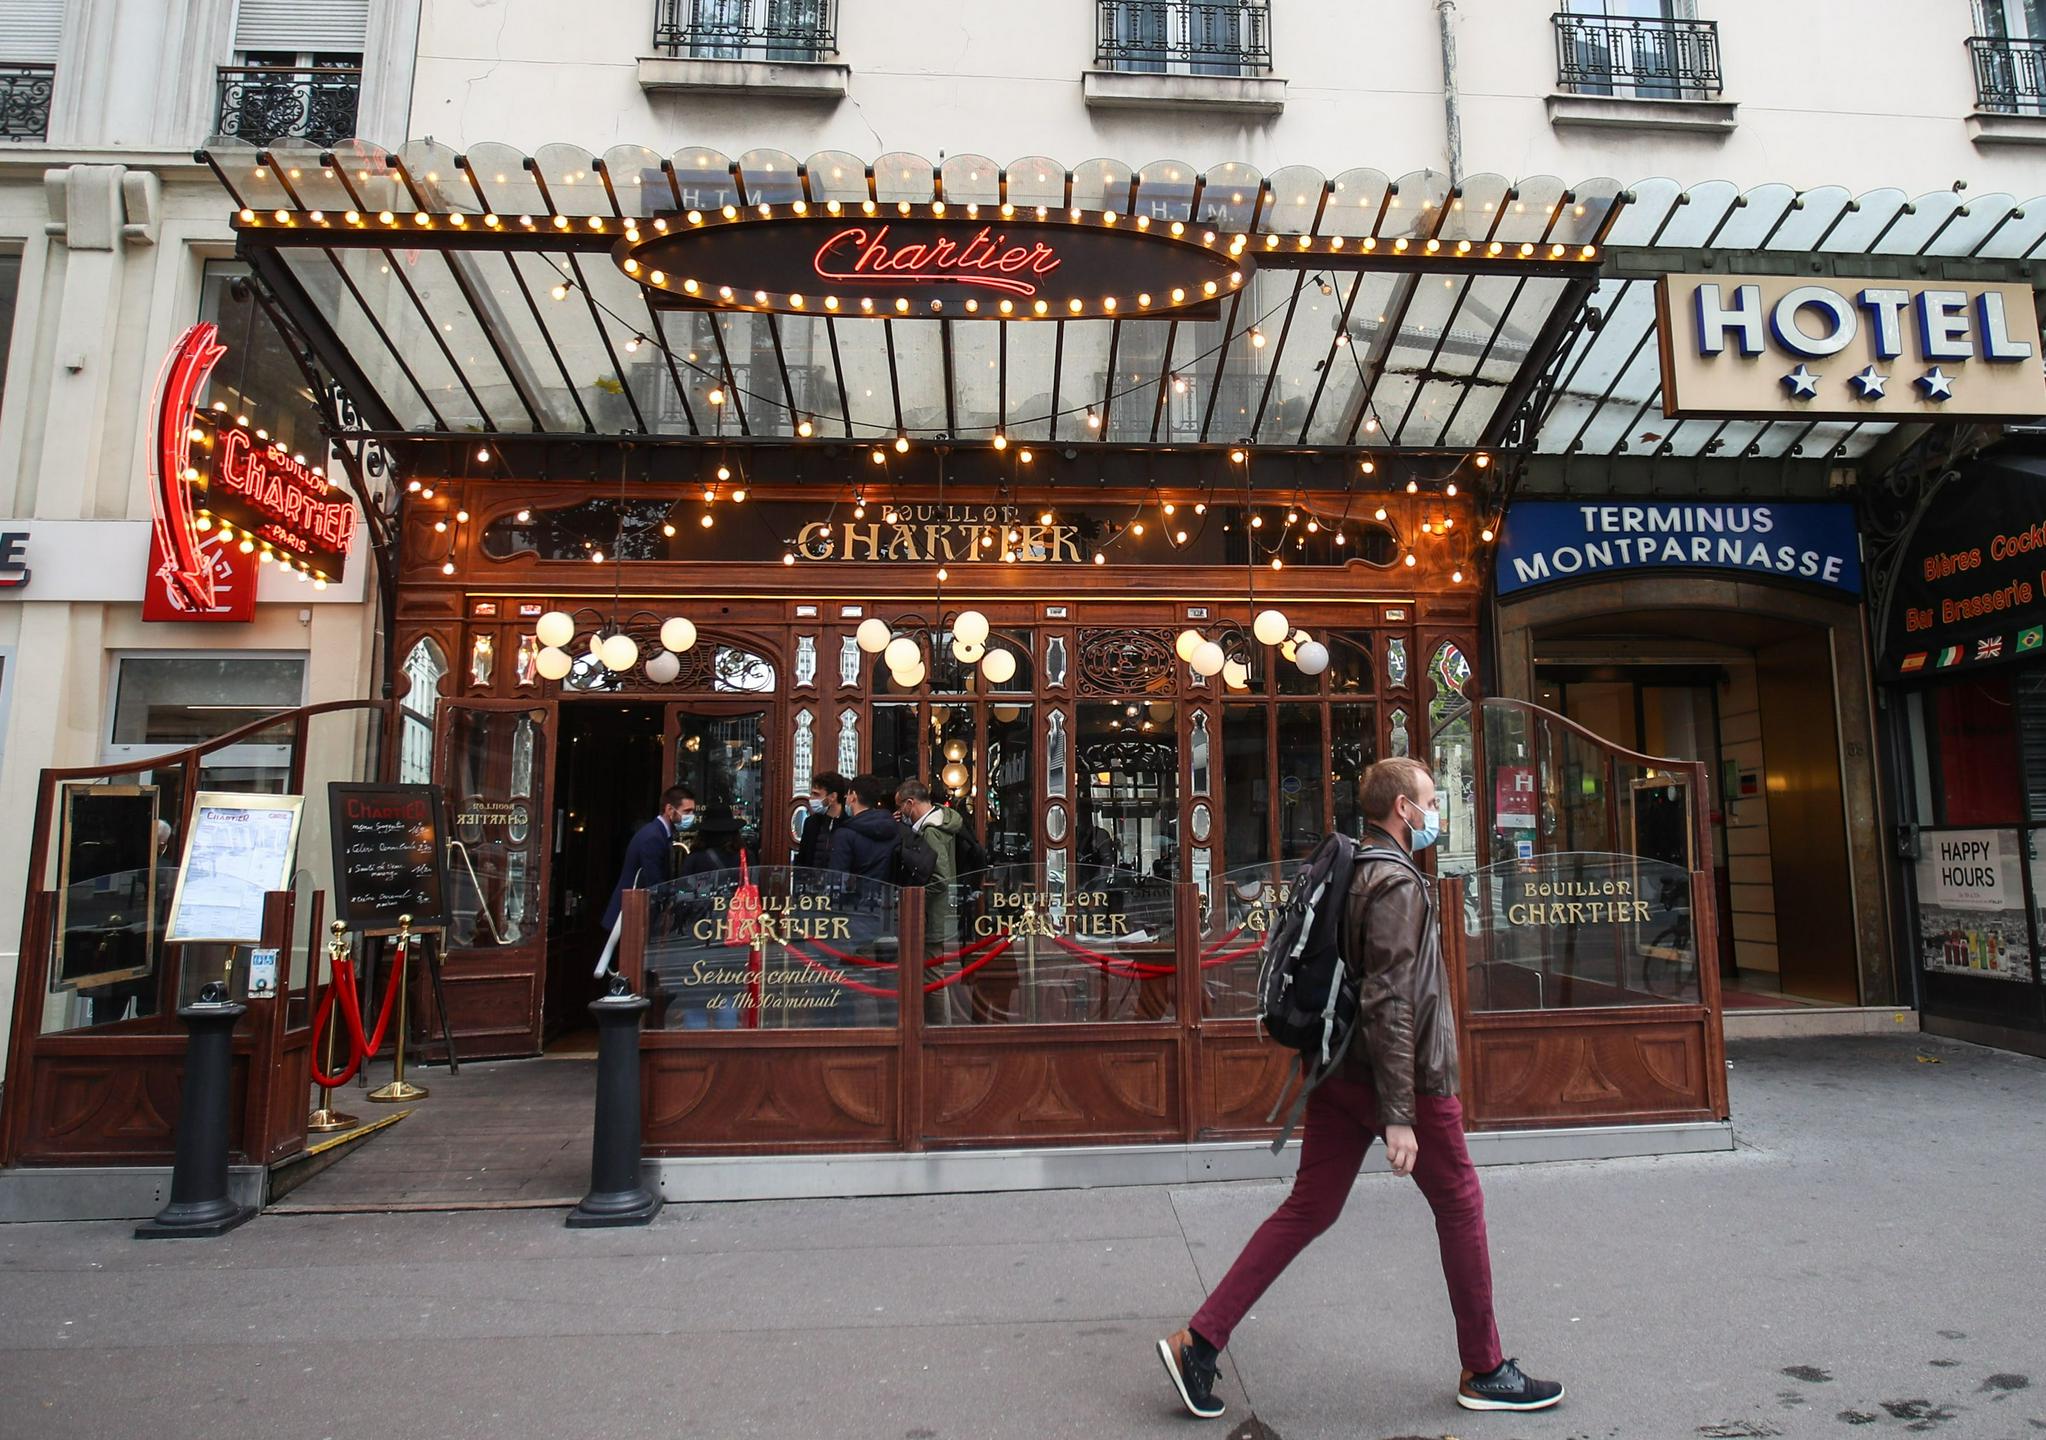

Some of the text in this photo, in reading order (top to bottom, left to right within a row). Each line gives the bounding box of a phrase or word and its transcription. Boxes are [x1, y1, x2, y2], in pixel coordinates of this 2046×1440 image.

[814, 225, 1062, 296] Chartier
[1694, 283, 2033, 361] HOTEL
[267, 445, 329, 496] BOUILLON
[882, 505, 1020, 523] BOULLON
[1580, 507, 1774, 533] TERMINUS
[273, 526, 308, 553] PARIS
[798, 522, 1081, 562] CHARTIER
[1513, 537, 1843, 583] MONTPARNASSE
[1924, 548, 1982, 582] Bières
[1906, 579, 2033, 632] Bar Brasserie
[1515, 775, 1534, 792] H
[1941, 841, 1990, 861] HAPPY
[1524, 881, 1632, 897] BOUILLON
[1942, 867, 1995, 887] HOURS
[713, 896, 831, 911] BOUILLON
[993, 892, 1108, 908] BOUILLON
[974, 913, 1129, 936] CHARTIER
[1508, 901, 1651, 925] CHARTIER
[693, 918, 851, 940] CHARTIER
[684, 959, 847, 987] Service continu
[706, 993, 727, 1009] de
[785, 989, 842, 1009] minuit
